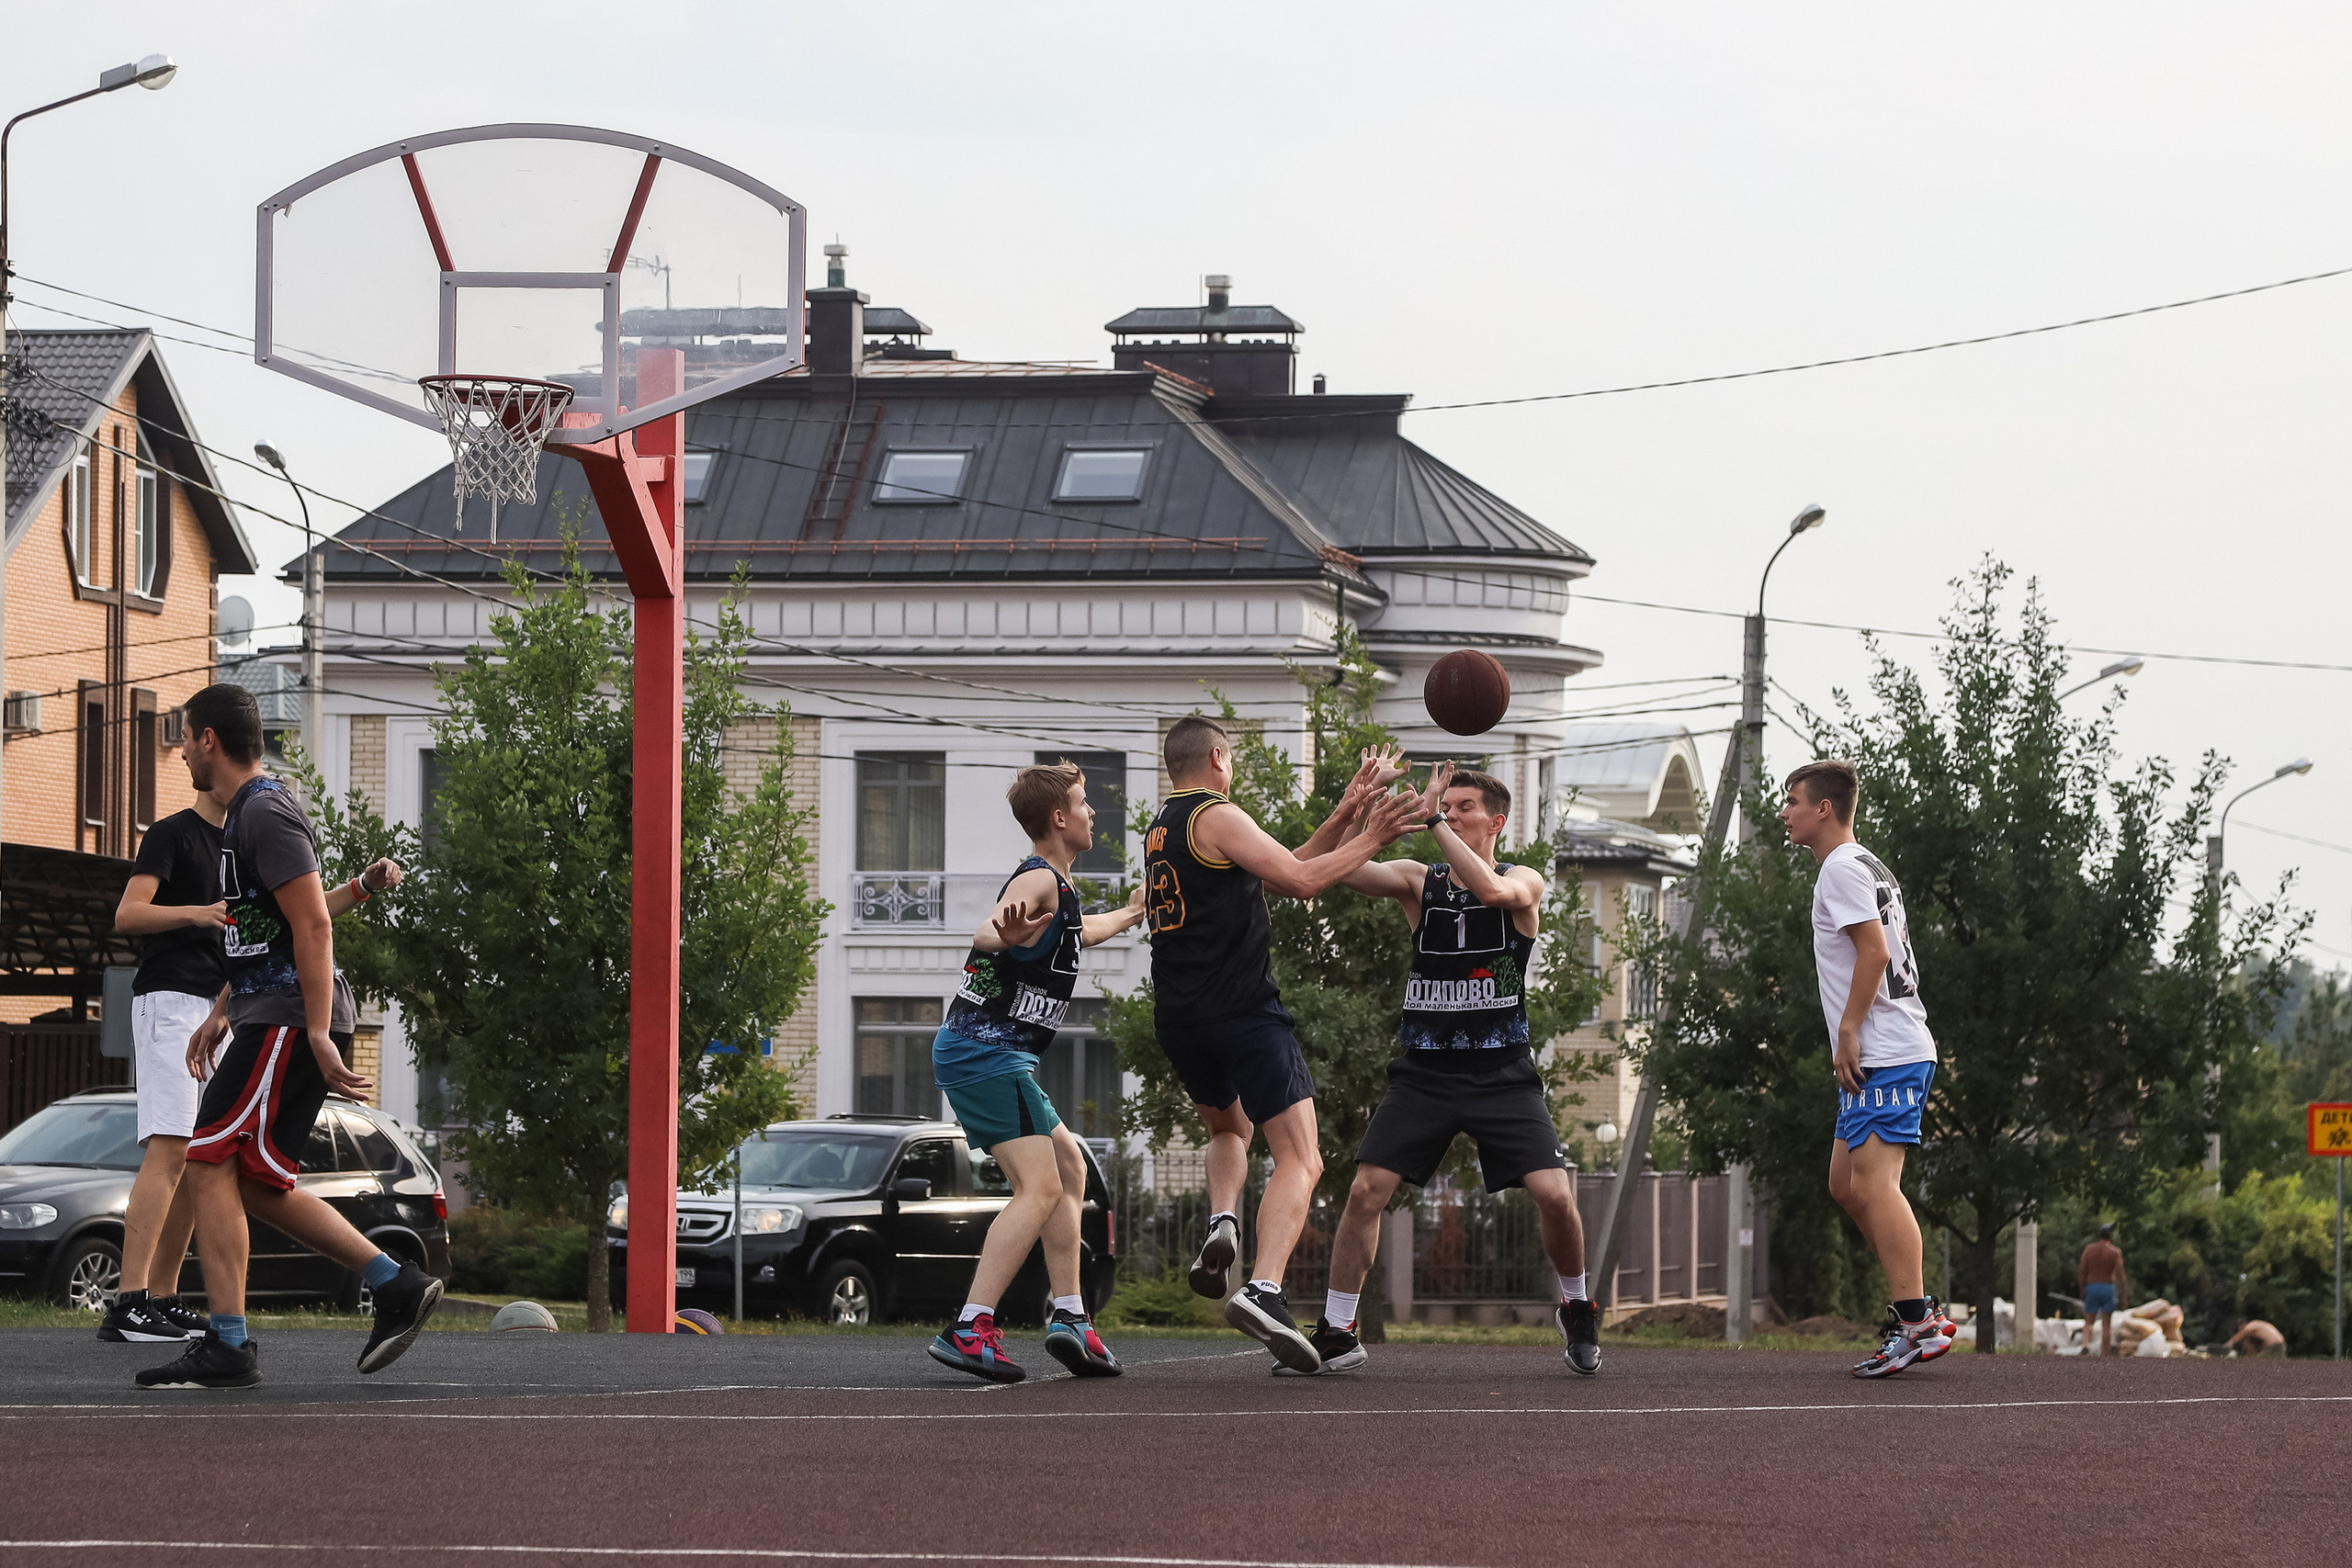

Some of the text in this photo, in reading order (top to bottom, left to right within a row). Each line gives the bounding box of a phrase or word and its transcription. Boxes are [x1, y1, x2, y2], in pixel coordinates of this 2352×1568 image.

[1453, 912, 1465, 949] 1
[1406, 977, 1496, 1002] ОТАПОВО
[1424, 1002, 1479, 1010] маленькая
[1481, 998, 1517, 1009] Москва
